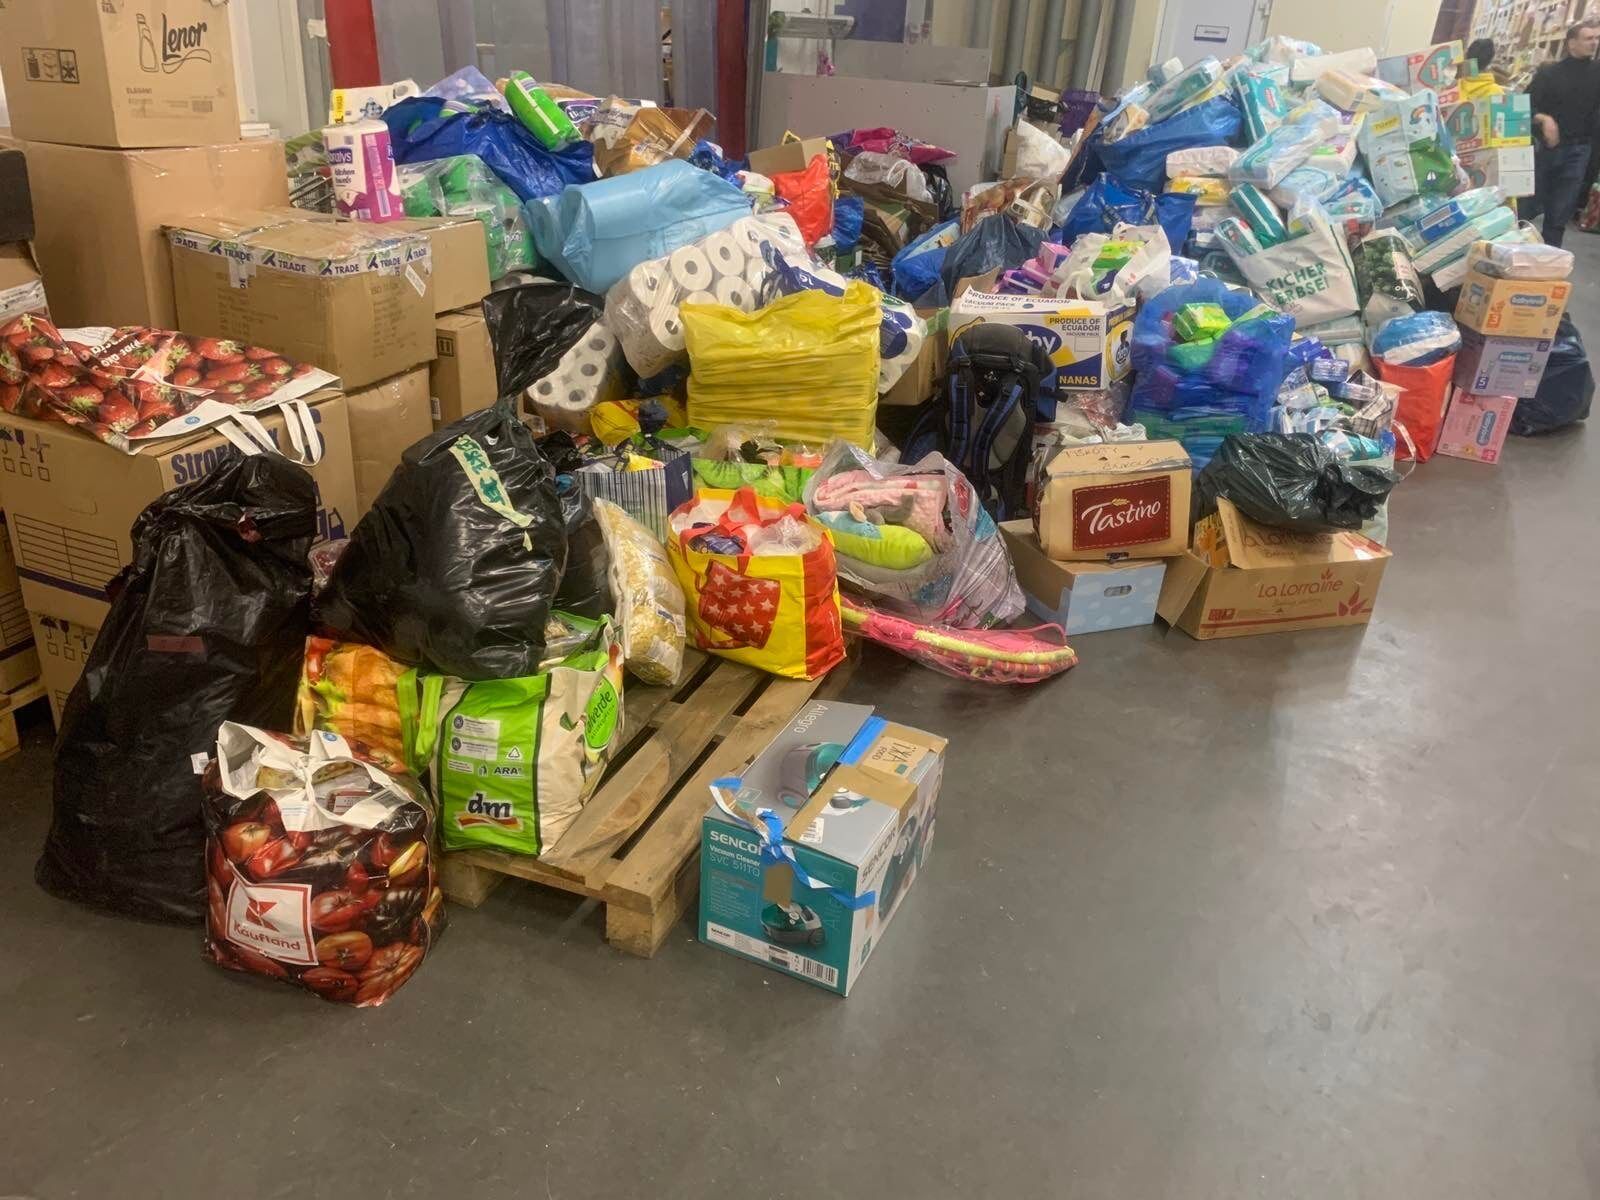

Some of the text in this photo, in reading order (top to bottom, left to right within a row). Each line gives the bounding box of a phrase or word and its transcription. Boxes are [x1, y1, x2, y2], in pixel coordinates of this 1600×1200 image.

[161, 12, 208, 62] Lenor
[224, 248, 251, 262] TRADE
[380, 256, 401, 268] TRADE
[413, 247, 427, 259] TRADE
[278, 259, 306, 273] TRADE
[334, 263, 360, 275] TRADE
[1265, 262, 1327, 291] KICHER
[967, 288, 1009, 302] PRODUCE
[1028, 297, 1072, 305] ECUADOR
[1049, 317, 1085, 325] PRODUCE
[1059, 375, 1099, 386] NANAS
[1081, 499, 1161, 534] Tastino
[1257, 579, 1343, 598] La Lorraine
[793, 703, 829, 734] Allegro
[468, 792, 512, 818] dm
[710, 844, 761, 867] Vacuum Cleaner
[233, 922, 301, 951] Kaufland
